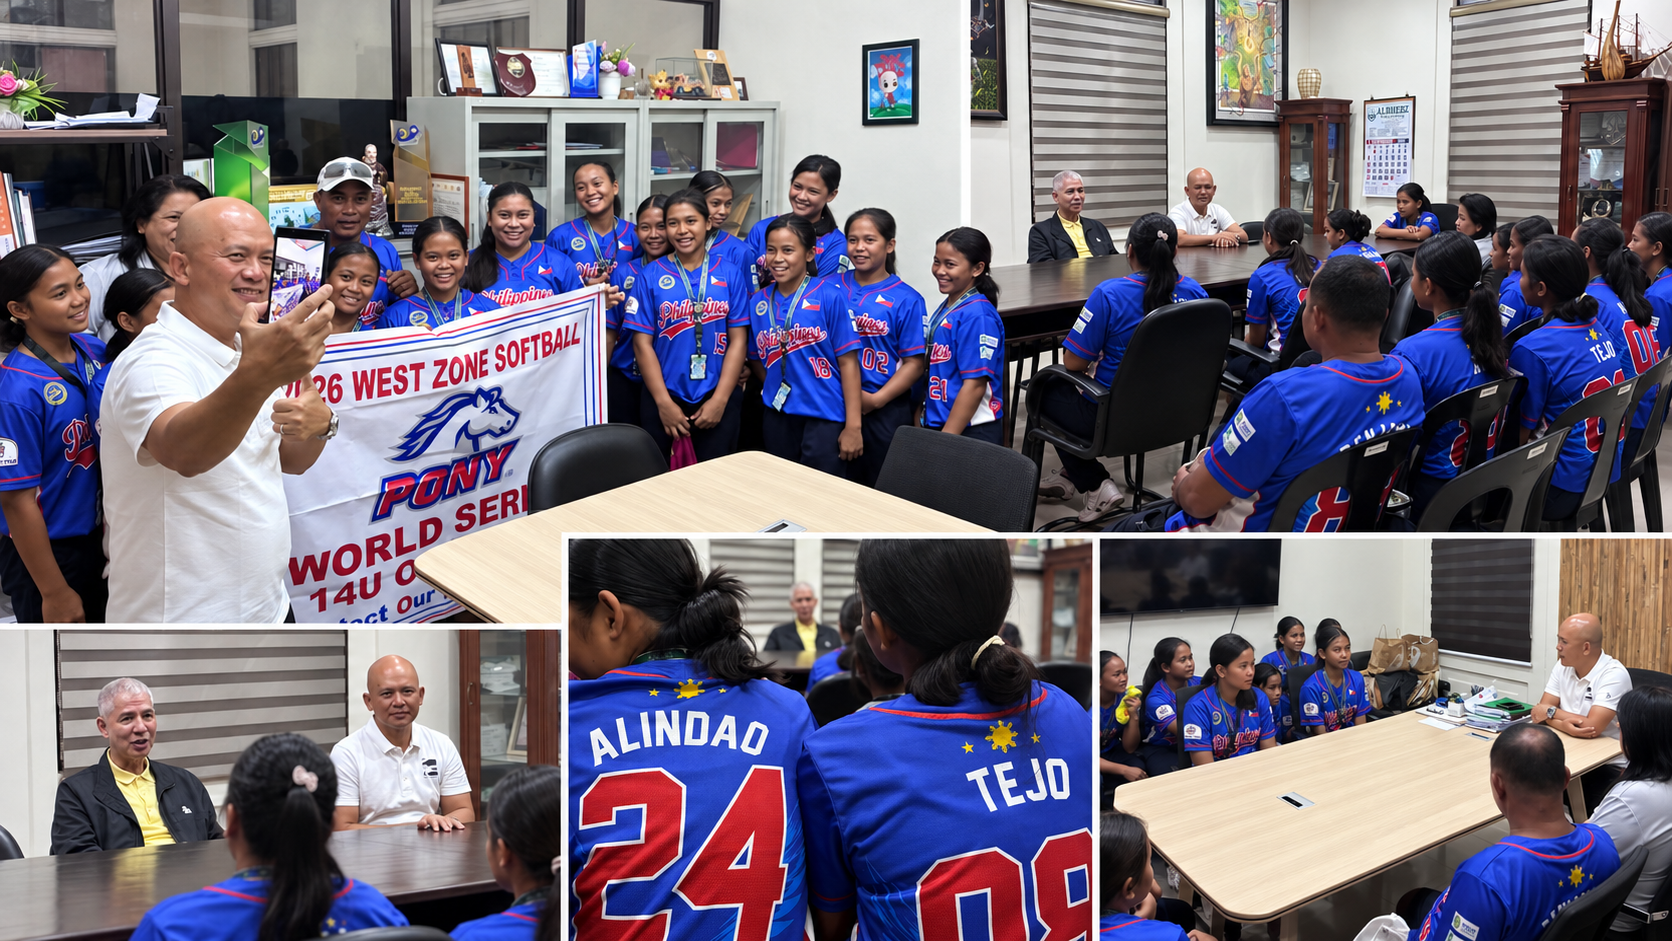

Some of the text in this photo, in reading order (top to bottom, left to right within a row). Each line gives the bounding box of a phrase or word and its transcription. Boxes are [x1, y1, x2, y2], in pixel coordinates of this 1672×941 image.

[352, 362, 425, 401] WEST
[432, 349, 488, 389] ZONE
[495, 321, 581, 373] SOFTBALL
[713, 332, 727, 355] 15
[862, 347, 889, 375] 02
[1589, 340, 1617, 363] TEJO
[809, 357, 832, 379] 18
[929, 375, 948, 402] 21
[370, 436, 522, 524] PONY
[288, 517, 443, 586] WORLD
[310, 571, 382, 613] 14U
[397, 589, 435, 614] Our
[589, 709, 770, 767] ALINDAO
[966, 758, 1071, 813] TEJO
[572, 765, 788, 941] 24
